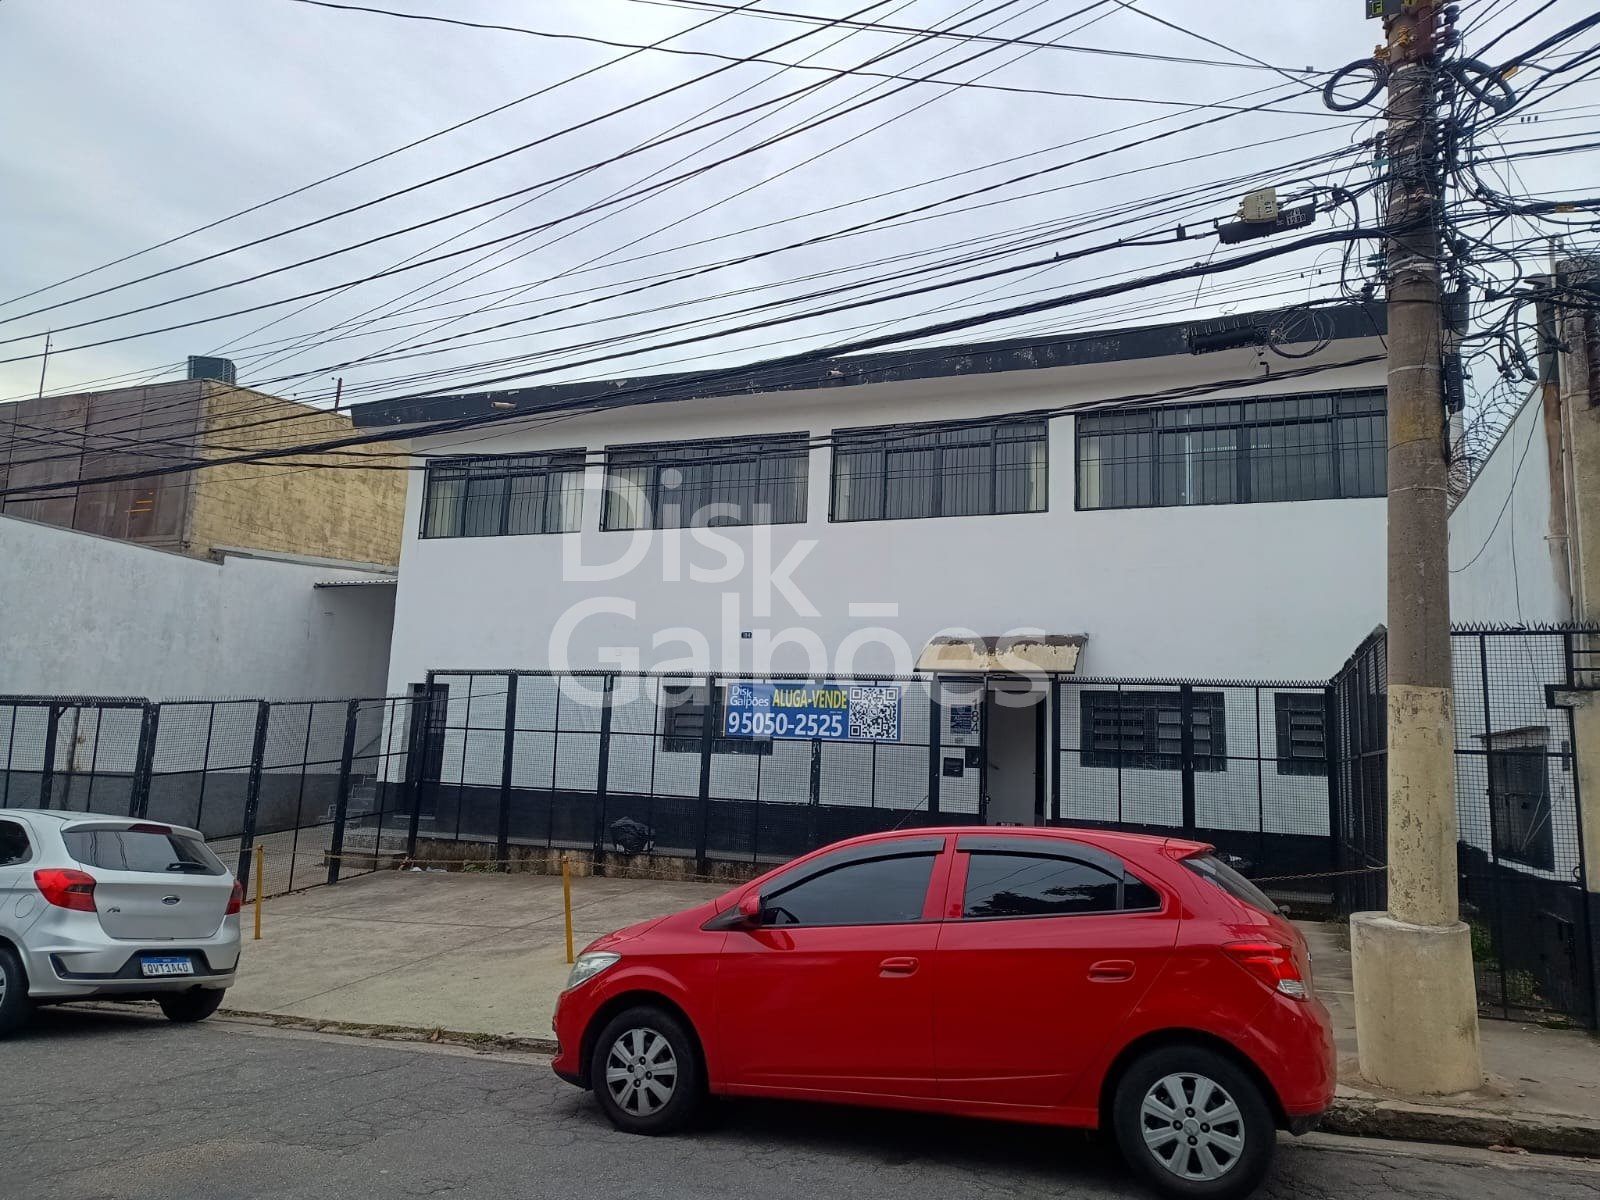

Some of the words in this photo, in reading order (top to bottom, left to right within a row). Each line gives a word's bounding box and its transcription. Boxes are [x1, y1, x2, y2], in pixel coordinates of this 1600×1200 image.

[731, 685, 753, 698] Disk
[772, 688, 848, 709] ALUGA-VENDE
[729, 696, 769, 709] Galpões
[728, 711, 843, 737] 95050-2525
